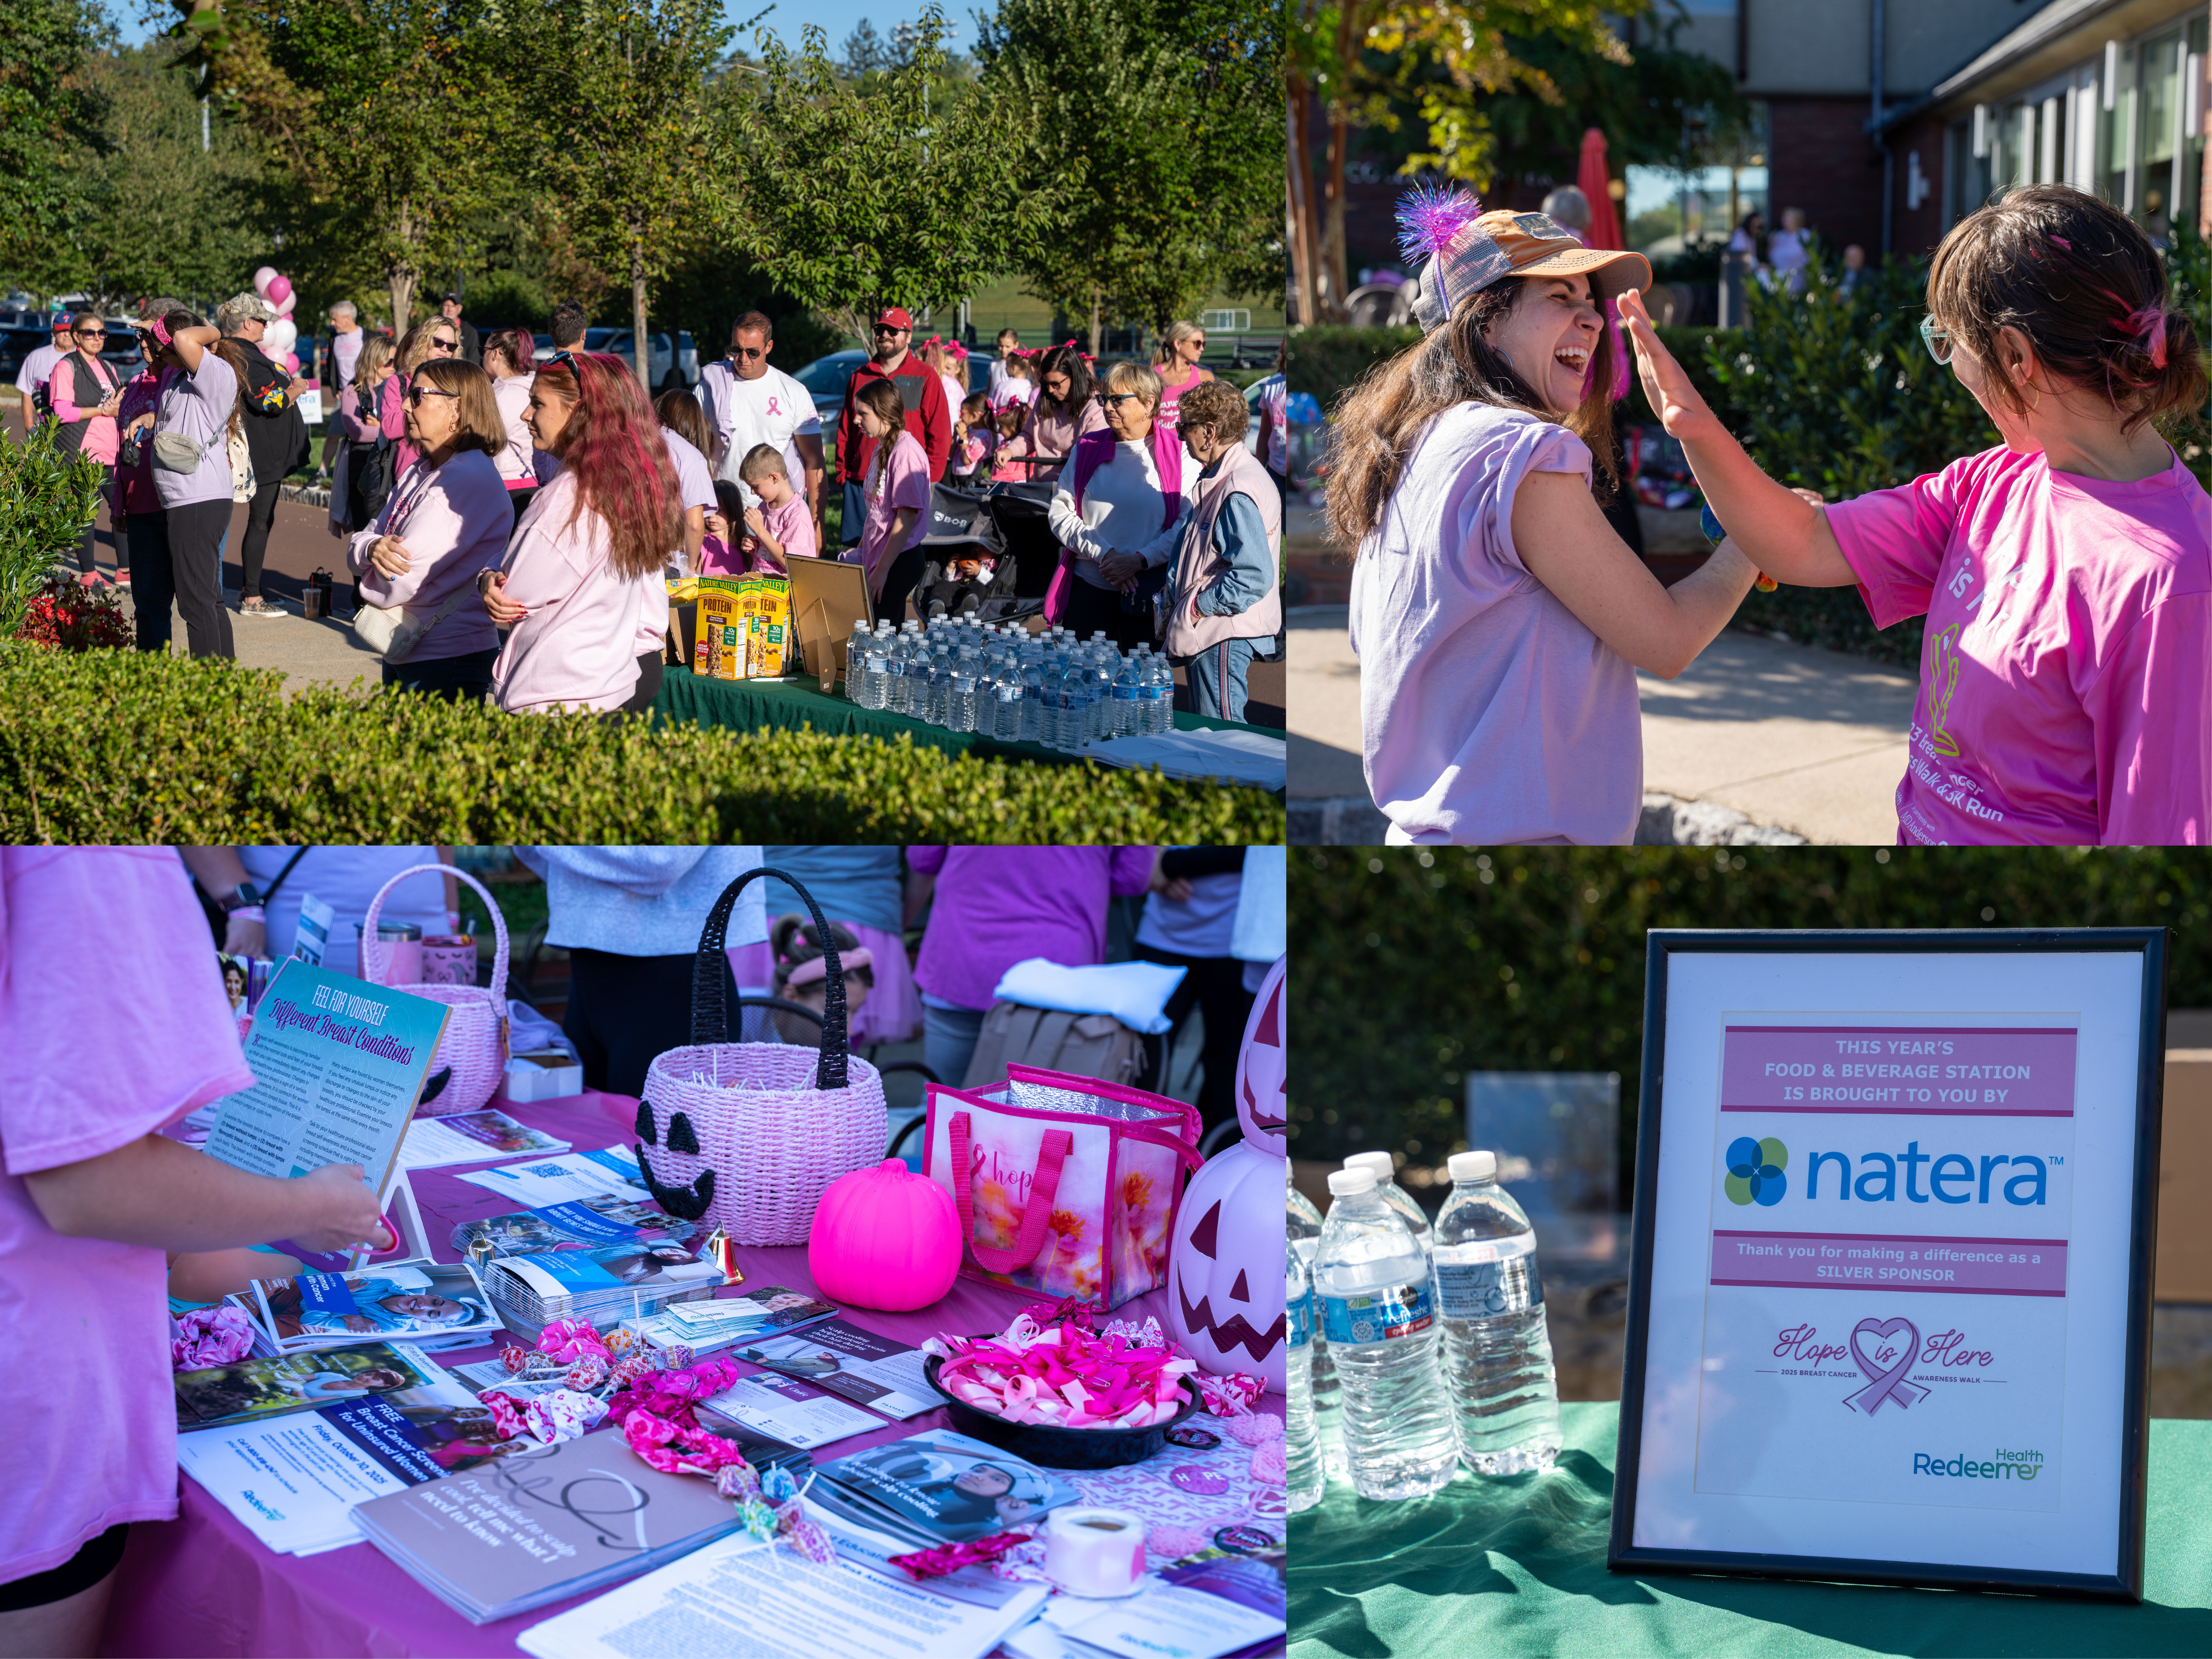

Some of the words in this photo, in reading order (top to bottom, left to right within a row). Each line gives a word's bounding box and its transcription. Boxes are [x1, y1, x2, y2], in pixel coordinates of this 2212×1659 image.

[298, 395, 315, 404] era
[700, 578, 719, 588] NATURE
[719, 581, 737, 593] VALLEY
[740, 583, 752, 592] NATURE
[763, 581, 783, 592] VALLEY
[1948, 557, 1974, 598] is
[703, 598, 732, 613] PROTEIN
[743, 601, 757, 609] PROTEIN
[761, 598, 776, 612] TEIN
[1915, 758, 1941, 787] Walk
[1937, 784, 1952, 796] &
[1945, 790, 1965, 809] 5K
[1966, 797, 2004, 822] Run
[1949, 774, 1984, 796] ncer
[1907, 821, 1936, 846] Anderson
[1927, 822, 1936, 832] with
[312, 985, 332, 1010] FEEL
[329, 990, 347, 1014] FOR
[346, 994, 389, 1027] YOURSELF
[269, 998, 321, 1032] Different
[318, 1014, 358, 1046] Breast
[355, 1027, 415, 1066] Conditions
[1835, 1040, 1881, 1055] THIS
[1887, 1041, 1954, 1055] YEAR’S
[331, 1061, 341, 1069] Many
[340, 1064, 352, 1073] lumps
[385, 1080, 406, 1092] themselves.
[1765, 1062, 1817, 1077] FOOD
[1822, 1063, 1835, 1078] &
[1841, 1063, 1939, 1078] BEVERAGE
[1945, 1065, 2031, 1079] STATION
[351, 1078, 365, 1087] unusual
[363, 1083, 375, 1092] lumps
[379, 1088, 392, 1097] notice
[1783, 1086, 1804, 1100] IS
[1809, 1087, 1901, 1102] BROUGHT
[1906, 1088, 1932, 1102] TO
[1937, 1088, 1978, 1102] YOU
[1983, 1089, 2009, 1103] BY
[993, 1151, 1034, 1203] hop
[1807, 1140, 2047, 1206] natera
[545, 1207, 566, 1219] ABOUT
[564, 1218, 583, 1229] GENES
[557, 1205, 576, 1217] WHAT
[573, 1214, 586, 1223] YOU
[1737, 1243, 1783, 1257] Thank
[1787, 1246, 1815, 1260] you
[1820, 1244, 1842, 1259] for
[1847, 1246, 1905, 1263] making
[1909, 1250, 1919, 1260] a
[1923, 1248, 2003, 1263] difference
[2007, 1251, 2027, 1264] as
[2030, 1252, 2041, 1264] a
[316, 1274, 330, 1290] Woman
[1817, 1264, 1874, 1279] SILVER
[1879, 1266, 1955, 1281] SPONSOR
[281, 1279, 290, 1289] American
[305, 1275, 317, 1284] With
[311, 1284, 324, 1302] Cancer
[804, 1332, 852, 1352] chemotherapy
[811, 1330, 831, 1339] their
[842, 1341, 867, 1351] during
[818, 1327, 838, 1337] helps
[834, 1333, 867, 1345] patients
[864, 1344, 886, 1353] retain
[826, 1325, 845, 1335] Scalp
[844, 1332, 870, 1343] cooling
[1773, 1323, 1848, 1368] Hope
[1875, 1342, 1898, 1363] is
[1921, 1328, 1994, 1367] Here
[788, 1386, 809, 1397] Claire
[374, 1402, 404, 1424] FREE
[880, 1402, 906, 1413] PAXMAN
[356, 1406, 392, 1432] Breast
[383, 1426, 418, 1453] Cancer
[311, 1423, 335, 1443] Friday,
[330, 1439, 361, 1463] October
[355, 1459, 371, 1472] 10,
[366, 1468, 389, 1485] 2025
[338, 1410, 357, 1423] for
[349, 1418, 399, 1456] Uninsured
[391, 1452, 430, 1482] Women
[1996, 1448, 2043, 1463] Health
[1913, 1453, 2043, 1481] Redeemer
[868, 1475, 900, 1495] scalp
[896, 1490, 942, 1520] cooling
[419, 1488, 457, 1514] need
[449, 1509, 470, 1524] to
[462, 1517, 506, 1550] know
[479, 1491, 532, 1527] decided
[466, 1500, 498, 1522] tell
[488, 1517, 516, 1536] me
[510, 1530, 549, 1558] what
